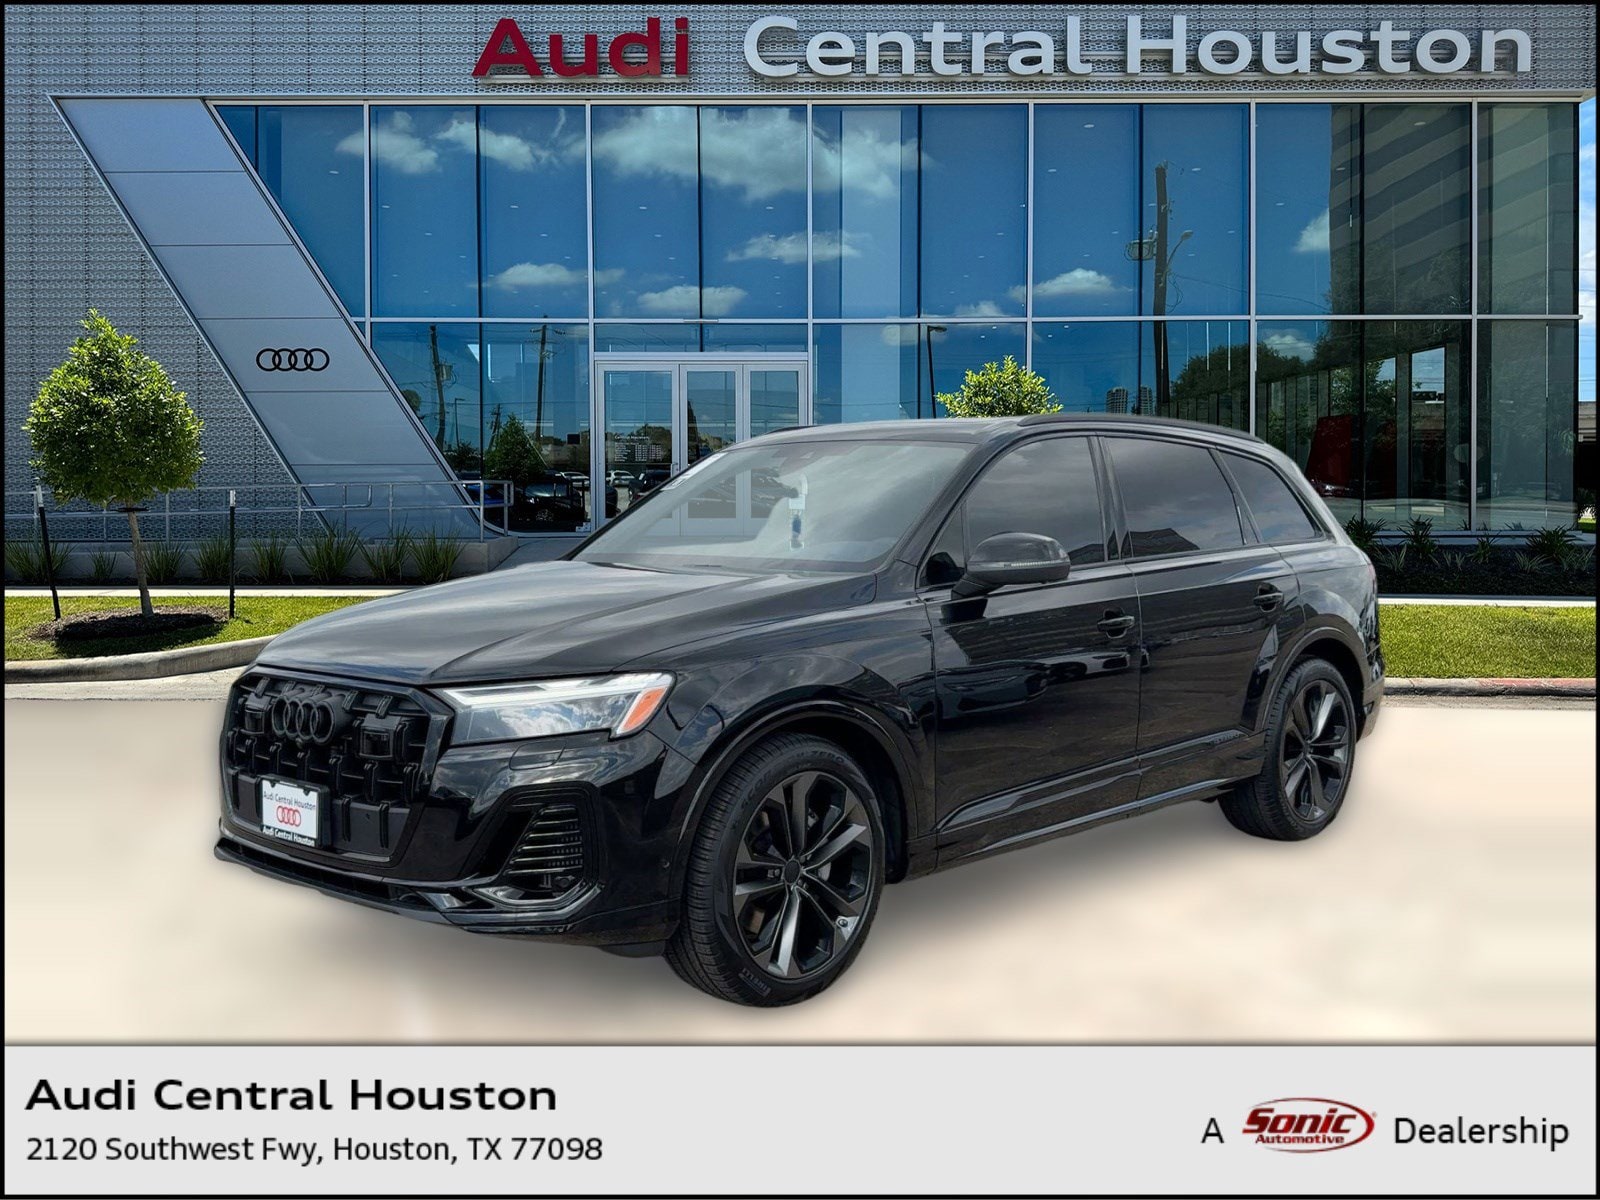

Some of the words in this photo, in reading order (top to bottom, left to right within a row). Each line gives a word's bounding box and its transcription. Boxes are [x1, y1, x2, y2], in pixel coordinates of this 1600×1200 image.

[471, 17, 689, 77] Audi
[744, 16, 1093, 77] Central
[1127, 15, 1532, 75] Houston
[275, 794, 293, 806] Central
[294, 799, 316, 811] Houston
[275, 829, 293, 842] Central
[294, 833, 315, 847] Houston
